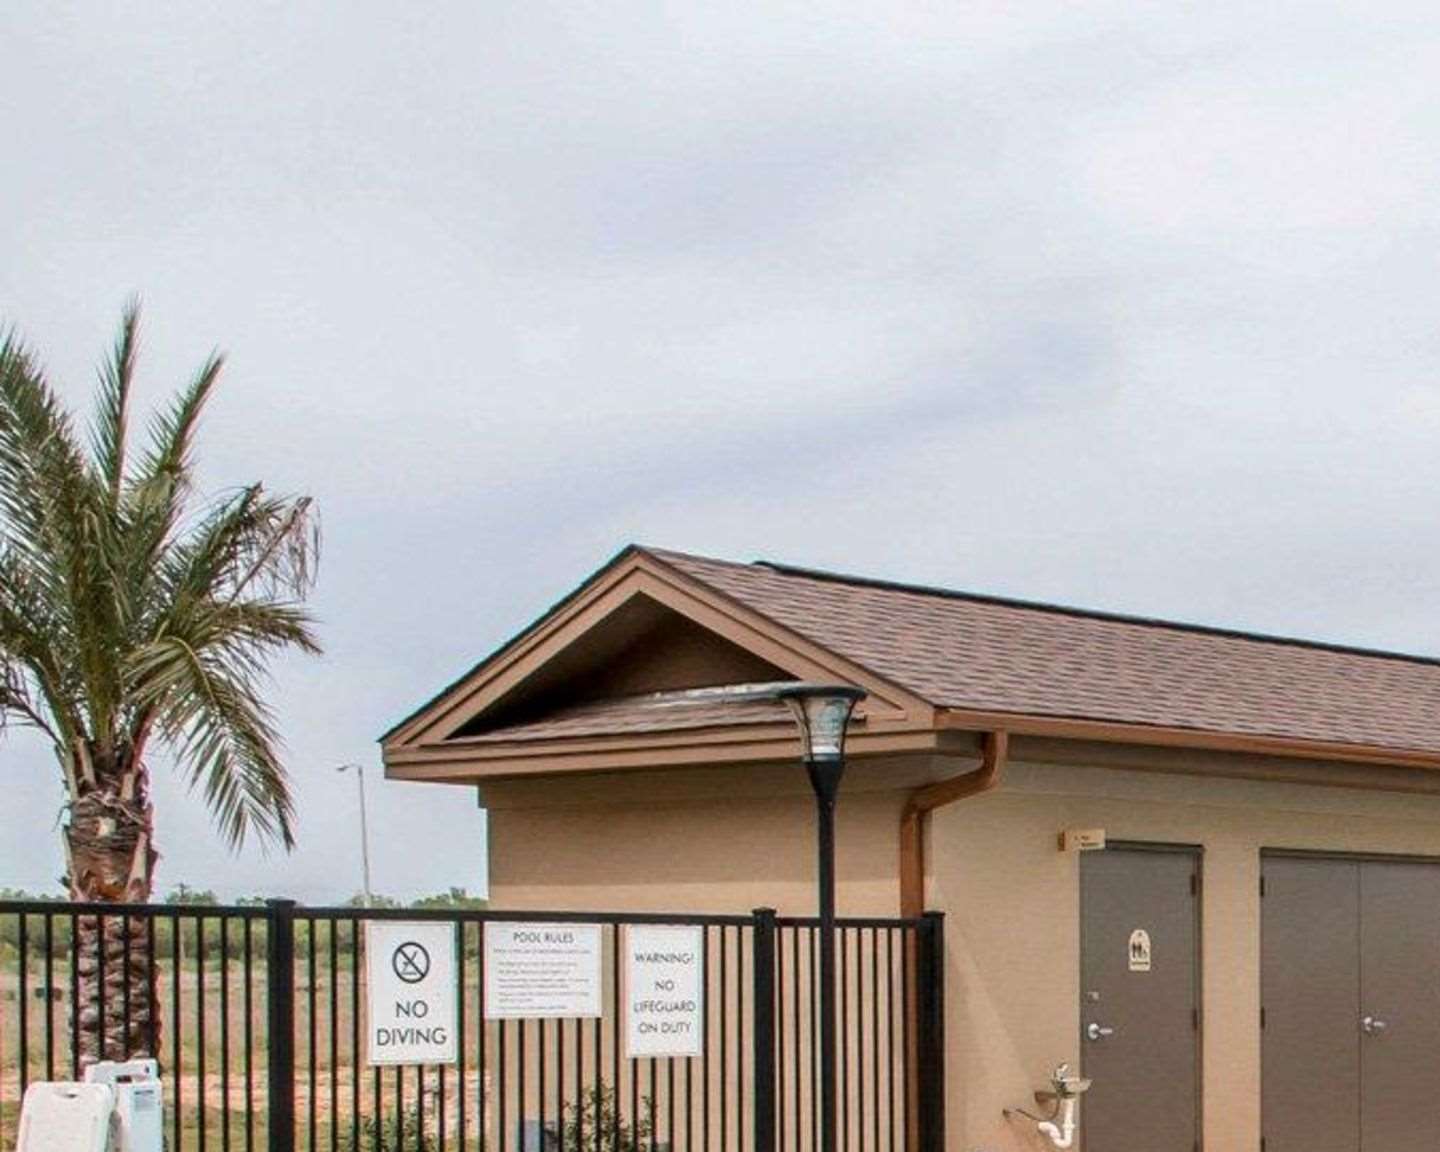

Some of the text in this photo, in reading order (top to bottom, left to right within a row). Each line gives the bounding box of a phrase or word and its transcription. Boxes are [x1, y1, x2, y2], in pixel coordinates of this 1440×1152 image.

[513, 931, 576, 943] POOL RULES
[634, 952, 694, 964] WARNING!
[655, 979, 675, 991] NO
[395, 999, 429, 1018] NO
[634, 999, 697, 1012] LIFEGUARD
[638, 1021, 692, 1033] ON DUTY
[376, 1027, 448, 1046] DIVING
